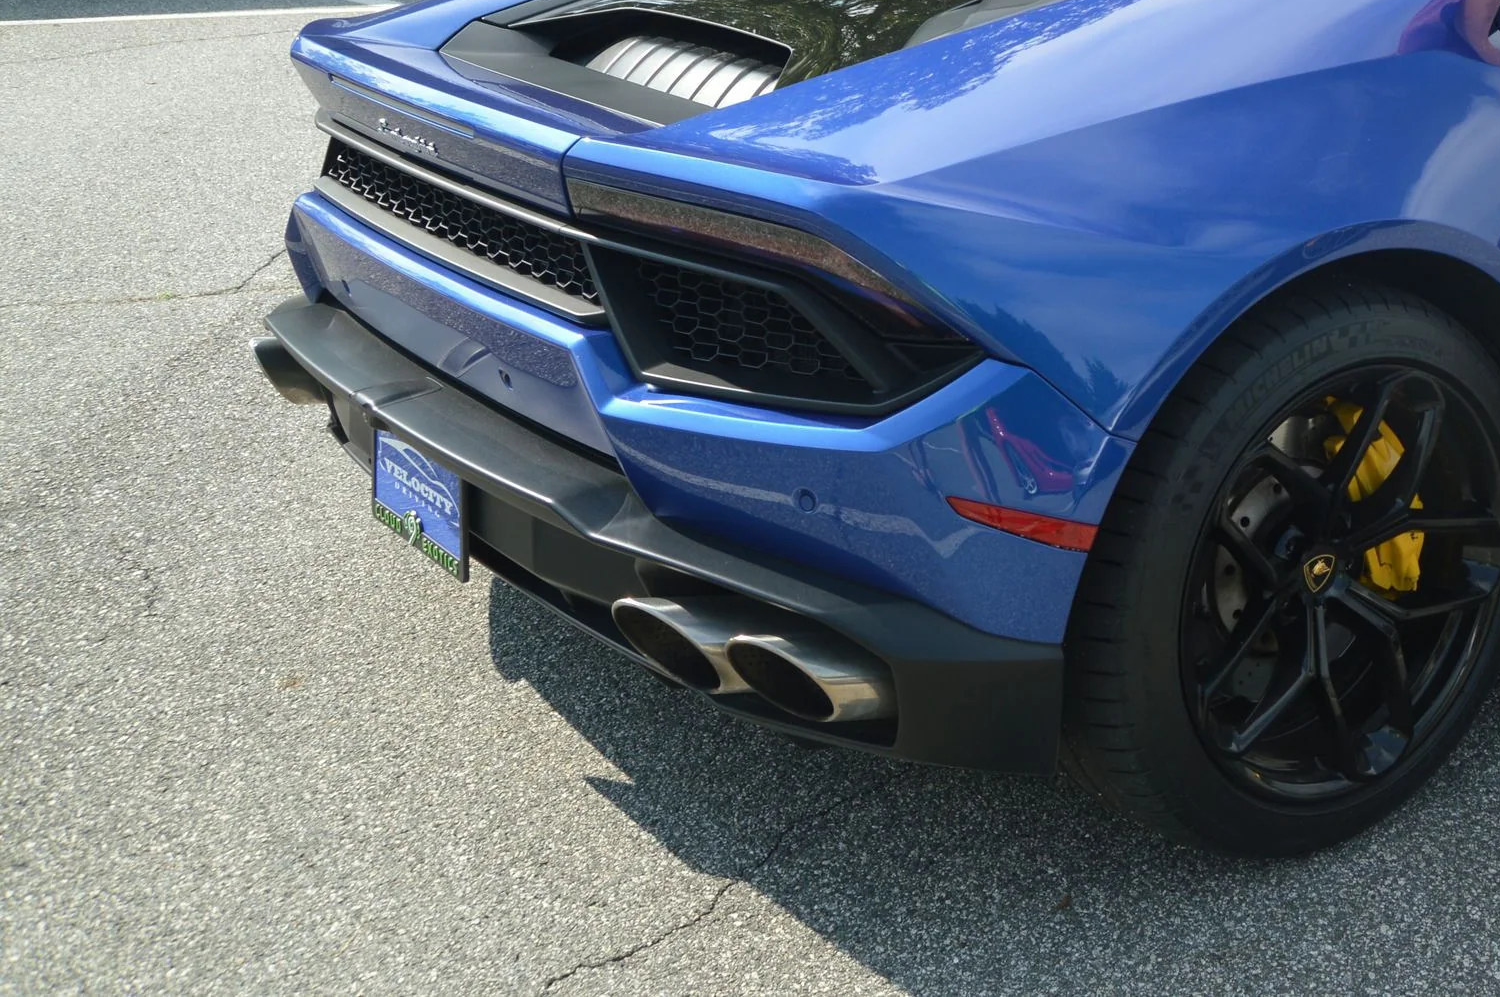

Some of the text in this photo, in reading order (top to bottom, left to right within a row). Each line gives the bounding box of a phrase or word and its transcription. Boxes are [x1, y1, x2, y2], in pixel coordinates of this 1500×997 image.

[1224, 334, 1329, 429] MICHELIN
[384, 457, 454, 516] VELOCITY
[375, 503, 403, 534] CLOUD
[421, 537, 459, 576] EXOTICS
